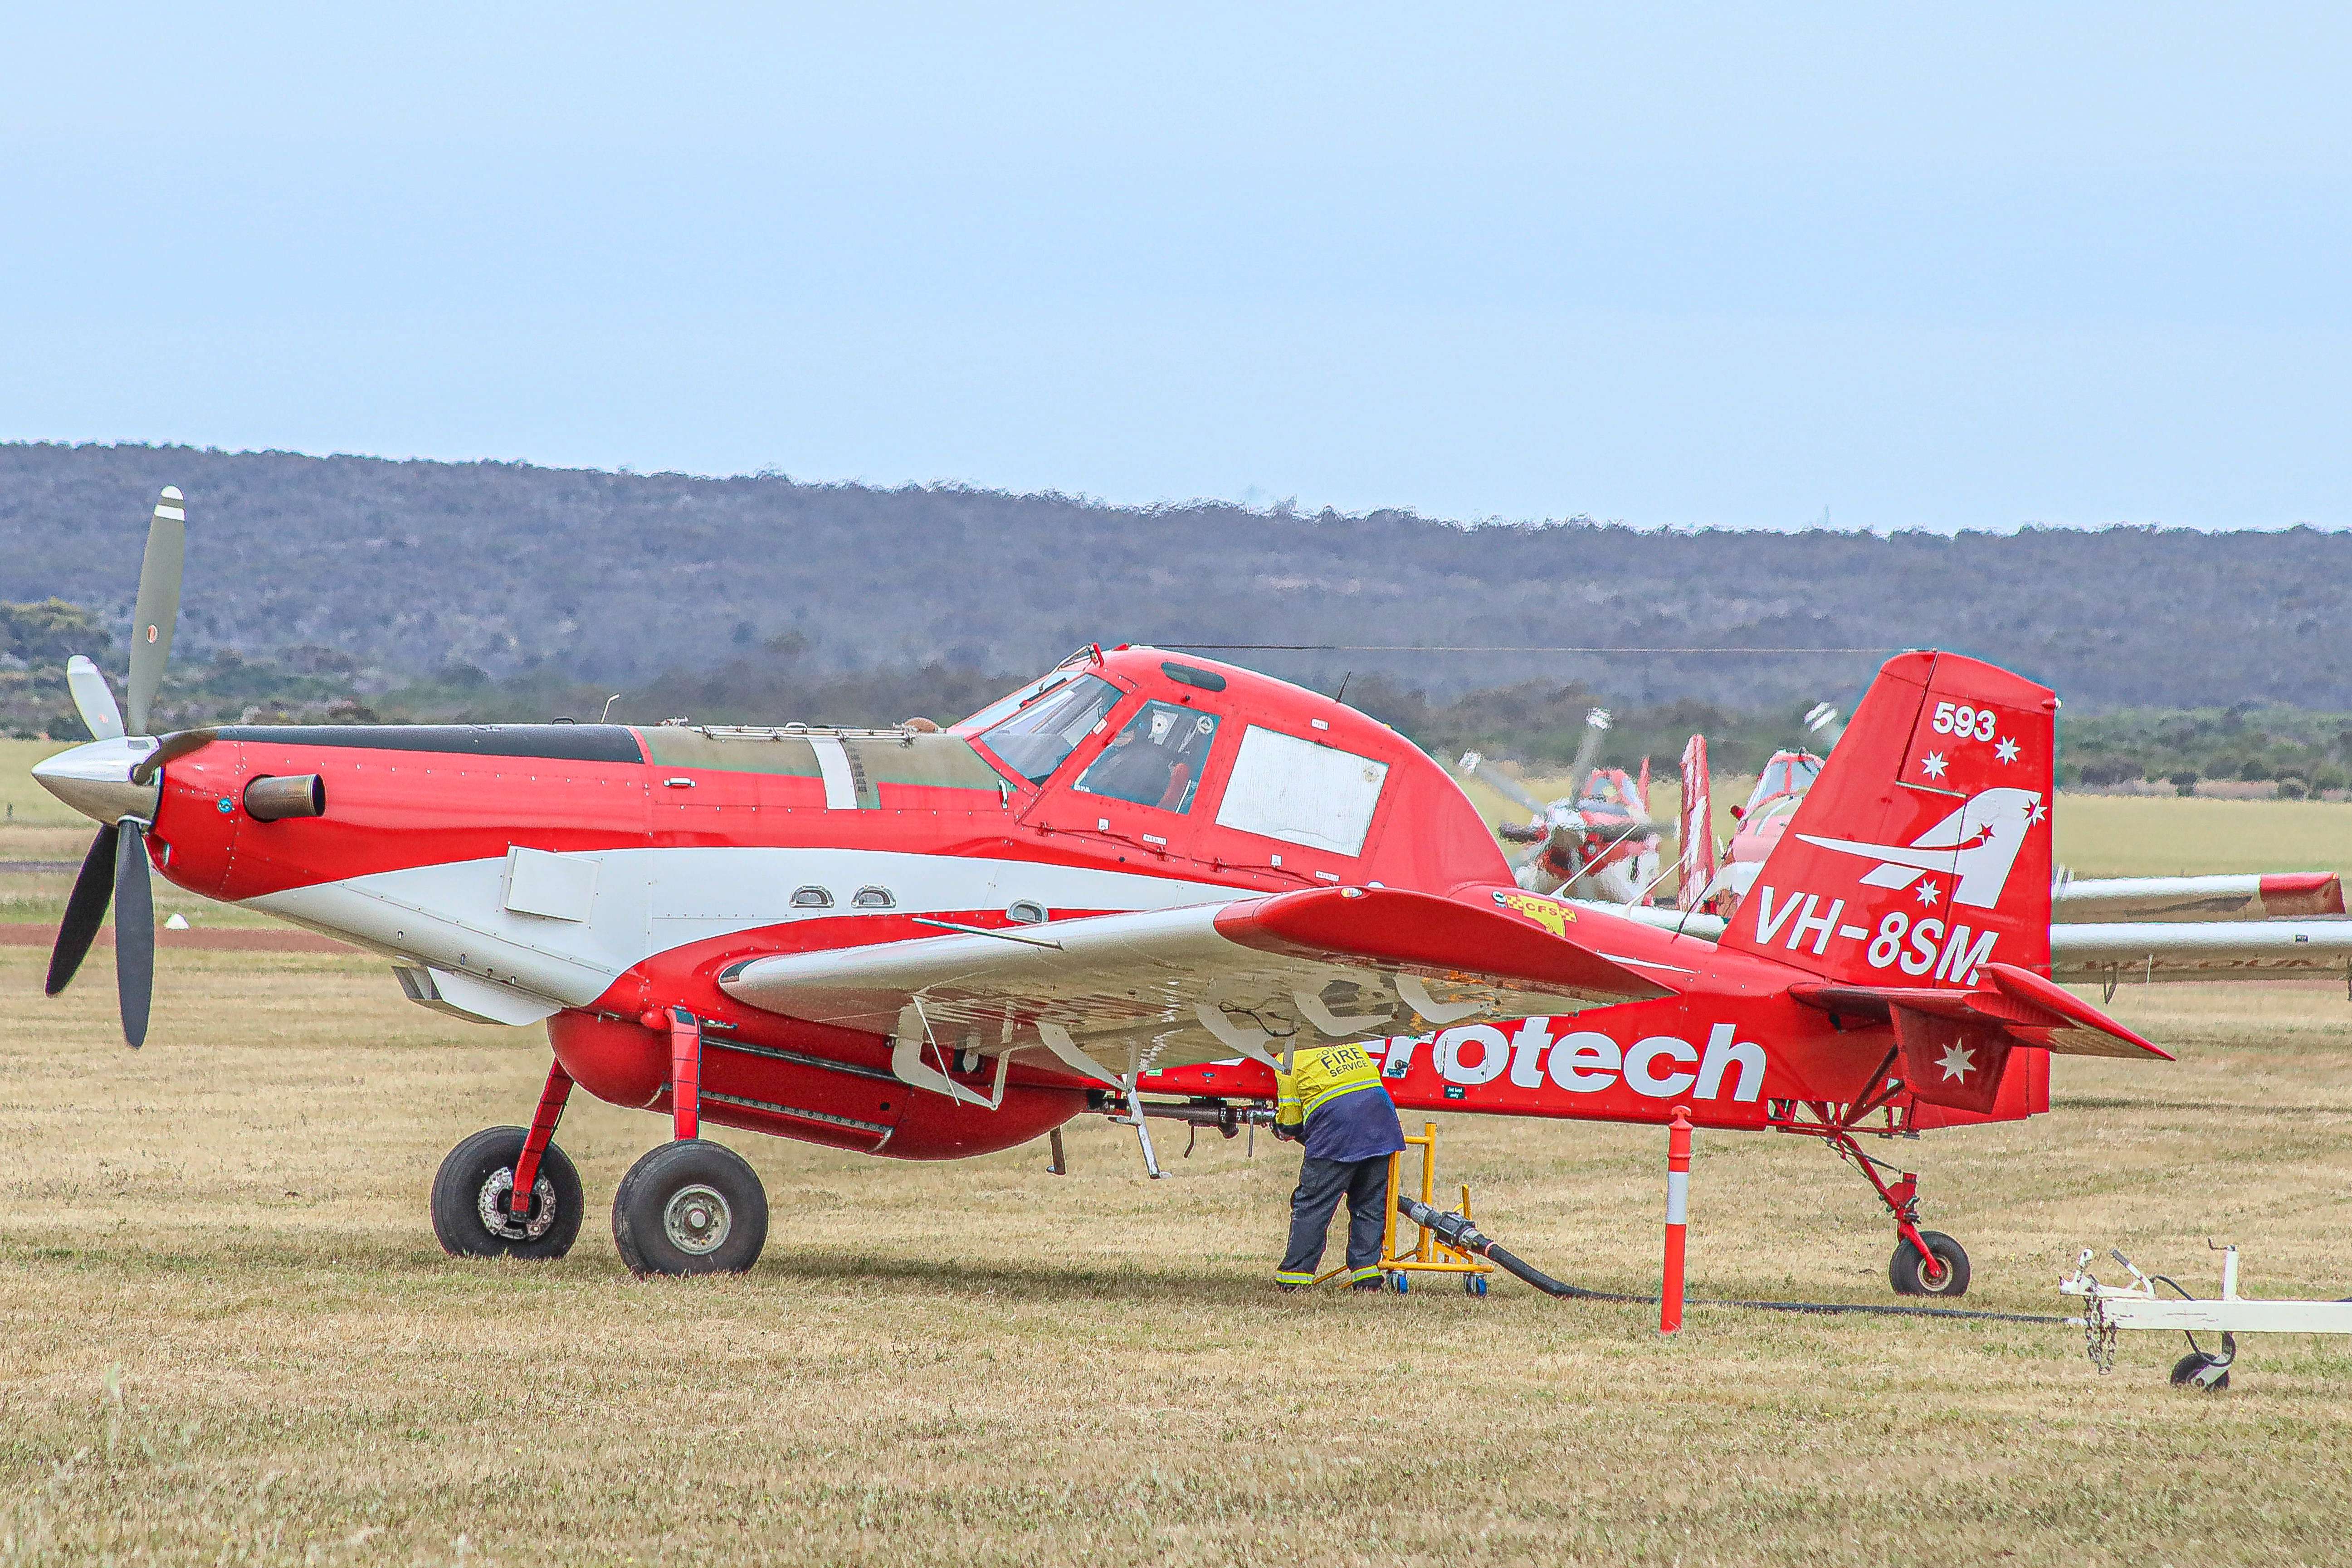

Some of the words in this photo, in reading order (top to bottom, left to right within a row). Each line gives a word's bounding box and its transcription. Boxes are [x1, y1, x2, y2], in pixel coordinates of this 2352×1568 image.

[1932, 701, 1996, 741] 593
[1525, 902, 1558, 916] CFS
[1755, 885, 1999, 986] VH-8SM
[1210, 1016, 1767, 1102] rotech
[1320, 1047, 1363, 1069] FIRE
[1329, 1060, 1368, 1077] SERVICE
